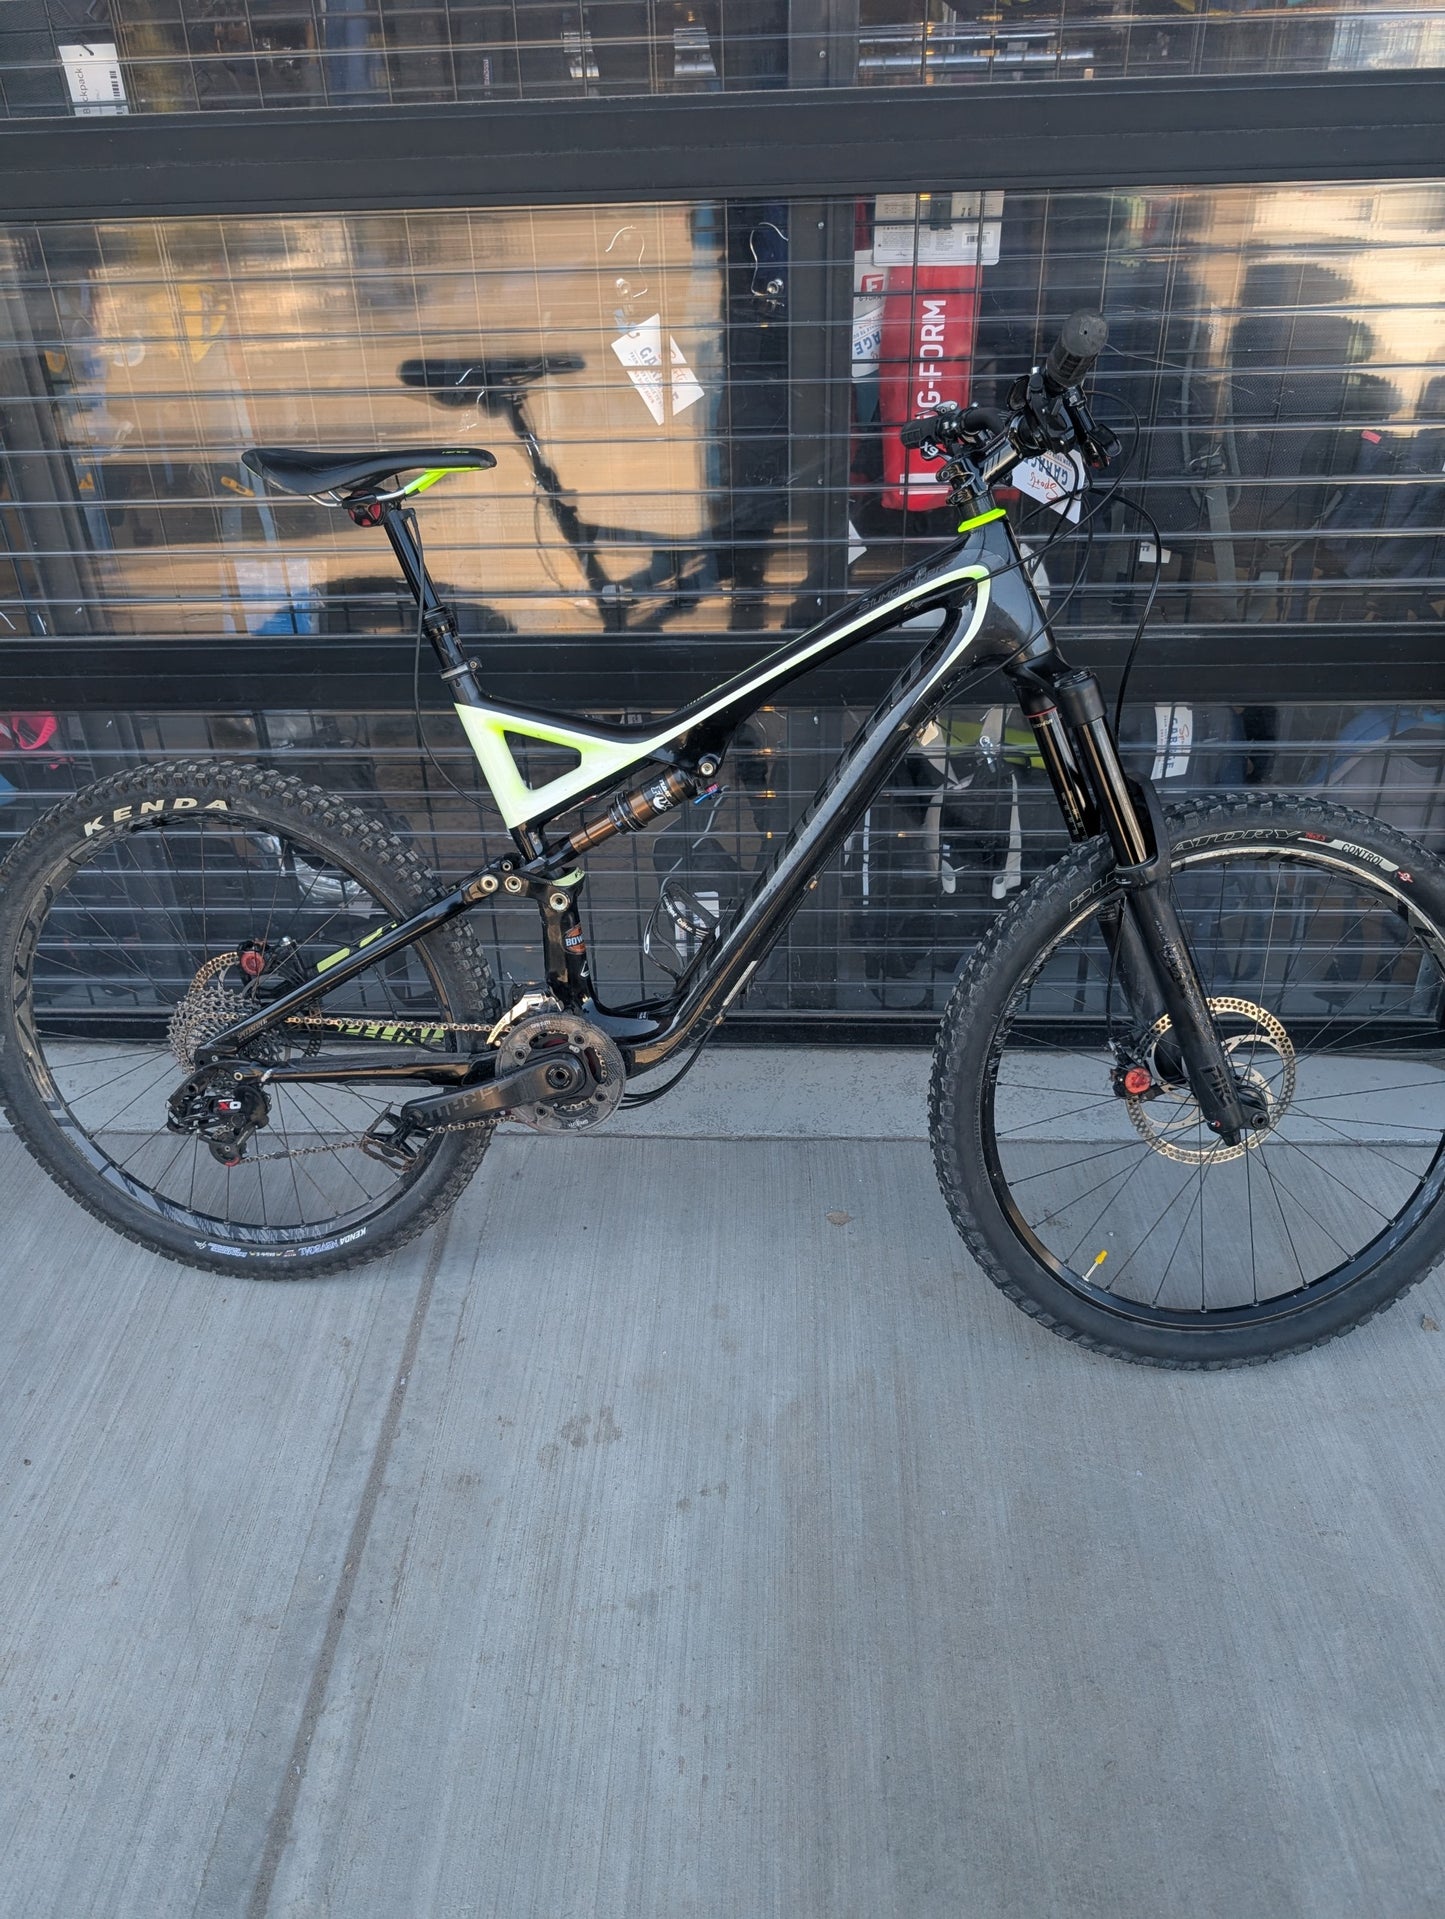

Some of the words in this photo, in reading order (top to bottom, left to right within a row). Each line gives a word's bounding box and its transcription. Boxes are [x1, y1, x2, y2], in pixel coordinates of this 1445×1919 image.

[75, 67, 91, 114] Bckpack
[917, 300, 947, 408] G-FORM
[1023, 455, 1069, 486] GARAG
[651, 785, 674, 811] FOX
[84, 797, 229, 838] KENDA
[1341, 843, 1385, 866] CONTROL
[340, 1226, 368, 1246] KENDA
